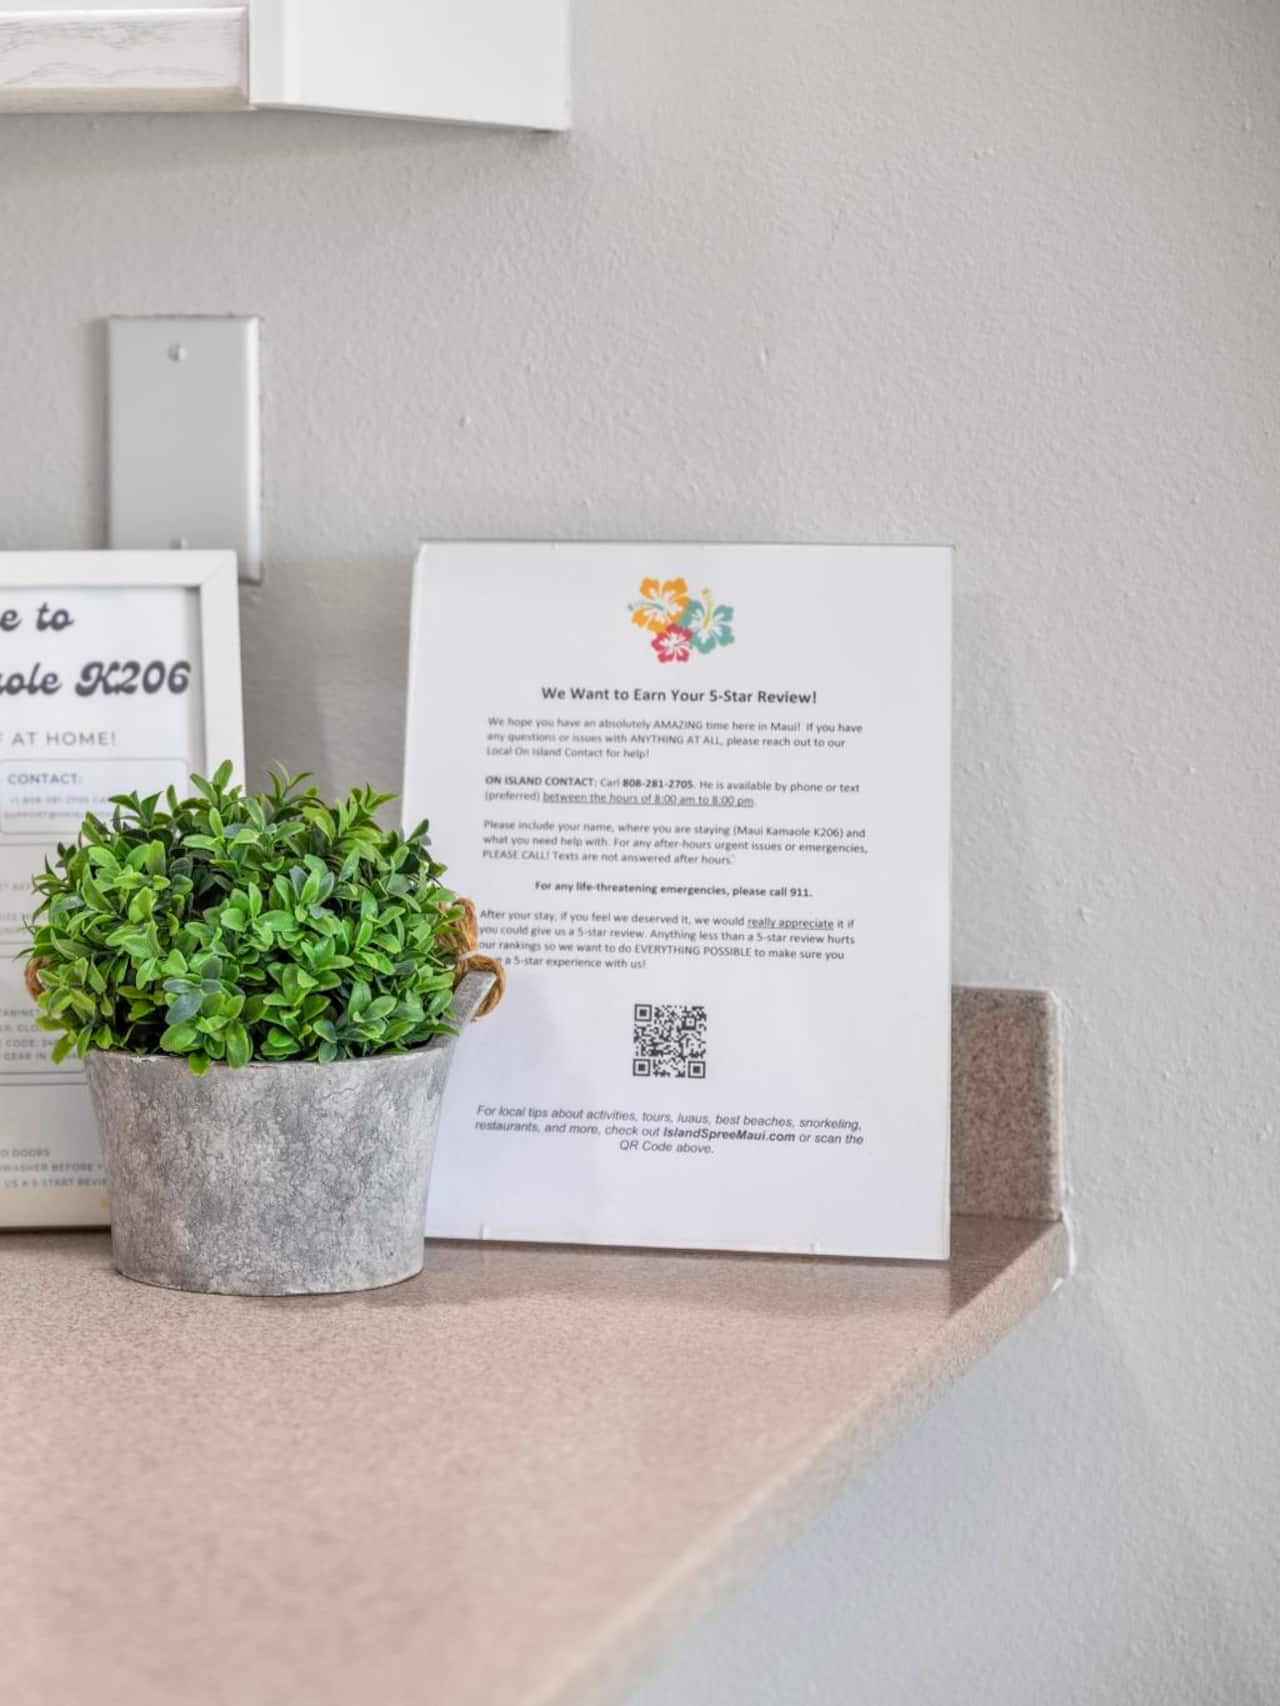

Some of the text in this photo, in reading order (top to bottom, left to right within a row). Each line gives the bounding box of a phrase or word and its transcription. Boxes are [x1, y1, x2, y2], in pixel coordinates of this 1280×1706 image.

[35, 602, 74, 631] to
[74, 660, 191, 696] K206
[541, 687, 816, 703] We Want to Earn Your 5-Star Review!
[488, 716, 504, 726] We
[507, 717, 532, 727] hope
[535, 719, 554, 728] you
[556, 718, 580, 727] have
[598, 719, 651, 729] absolutely
[652, 719, 703, 729] AMAZING
[705, 721, 729, 729] time
[731, 721, 756, 730] here
[757, 721, 768, 730] in
[770, 722, 802, 731] Maui!
[806, 722, 814, 731] If
[816, 724, 835, 733] you
[837, 723, 862, 732] have
[11, 731, 36, 745] AT
[46, 731, 115, 745] HOME!
[486, 746, 649, 759] Local On Island Contact for help!
[484, 776, 502, 784] ON
[504, 776, 542, 785] ISLAND
[600, 777, 620, 787] Carl
[699, 780, 713, 789] He
[716, 781, 724, 789] is
[726, 780, 772, 790] available
[774, 782, 787, 792] by
[790, 782, 822, 792] phone
[839, 784, 859, 792] text
[484, 790, 540, 801] (preferred)
[543, 792, 587, 803] between
[590, 792, 606, 804] the
[609, 792, 638, 805] hours
[640, 793, 651, 805] of
[654, 793, 677, 806] 8:00
[679, 796, 695, 806] am
[697, 796, 709, 806] to
[711, 795, 735, 807] 8:00
[483, 819, 515, 829] Please
[518, 820, 554, 830] include
[557, 823, 580, 832] your
[617, 823, 650, 832] where
[652, 825, 671, 834] you
[693, 825, 730, 836] staying
[732, 826, 763, 835] (Maui
[765, 826, 810, 836] Kamaole
[813, 827, 844, 837] K206)
[846, 829, 865, 837] and
[535, 881, 551, 890] For
[554, 883, 574, 892] any
[576, 881, 658, 894] life-threatening
[732, 886, 766, 896] please
[769, 887, 787, 896] call
[480, 909, 505, 919] After
[508, 912, 530, 920] your
[560, 911, 567, 919] if
[569, 913, 588, 922] you
[591, 912, 610, 921] feel
[630, 913, 678, 923] deserved
[712, 916, 744, 925] would
[746, 916, 776, 929] really
[779, 919, 834, 930] appreciate
[836, 920, 844, 928] it
[847, 919, 854, 928] if
[480, 926, 498, 934] you
[500, 925, 528, 935] could
[530, 927, 551, 937] give
[577, 927, 607, 936] 5-star
[649, 929, 696, 941] Anything
[698, 930, 718, 940] less
[720, 931, 745, 941] than
[746, 933, 754, 941] a
[756, 932, 787, 942] 5-star
[789, 935, 824, 943] review
[827, 934, 855, 943] hurts
[476, 1104, 496, 1116] For
[498, 1106, 526, 1117] local
[528, 1107, 549, 1120] tips
[550, 1108, 584, 1119] about
[715, 1114, 741, 1125] best
[544, 1122, 567, 1133] and
[604, 1124, 639, 1135] check
[641, 1126, 660, 1136] out
[663, 1126, 796, 1142] IslandSpreeMaui.com
[798, 1133, 812, 1142] or
[814, 1134, 842, 1143] scan
[845, 1134, 864, 1144] the
[619, 1139, 639, 1150] QR
[641, 1140, 673, 1151] Code
